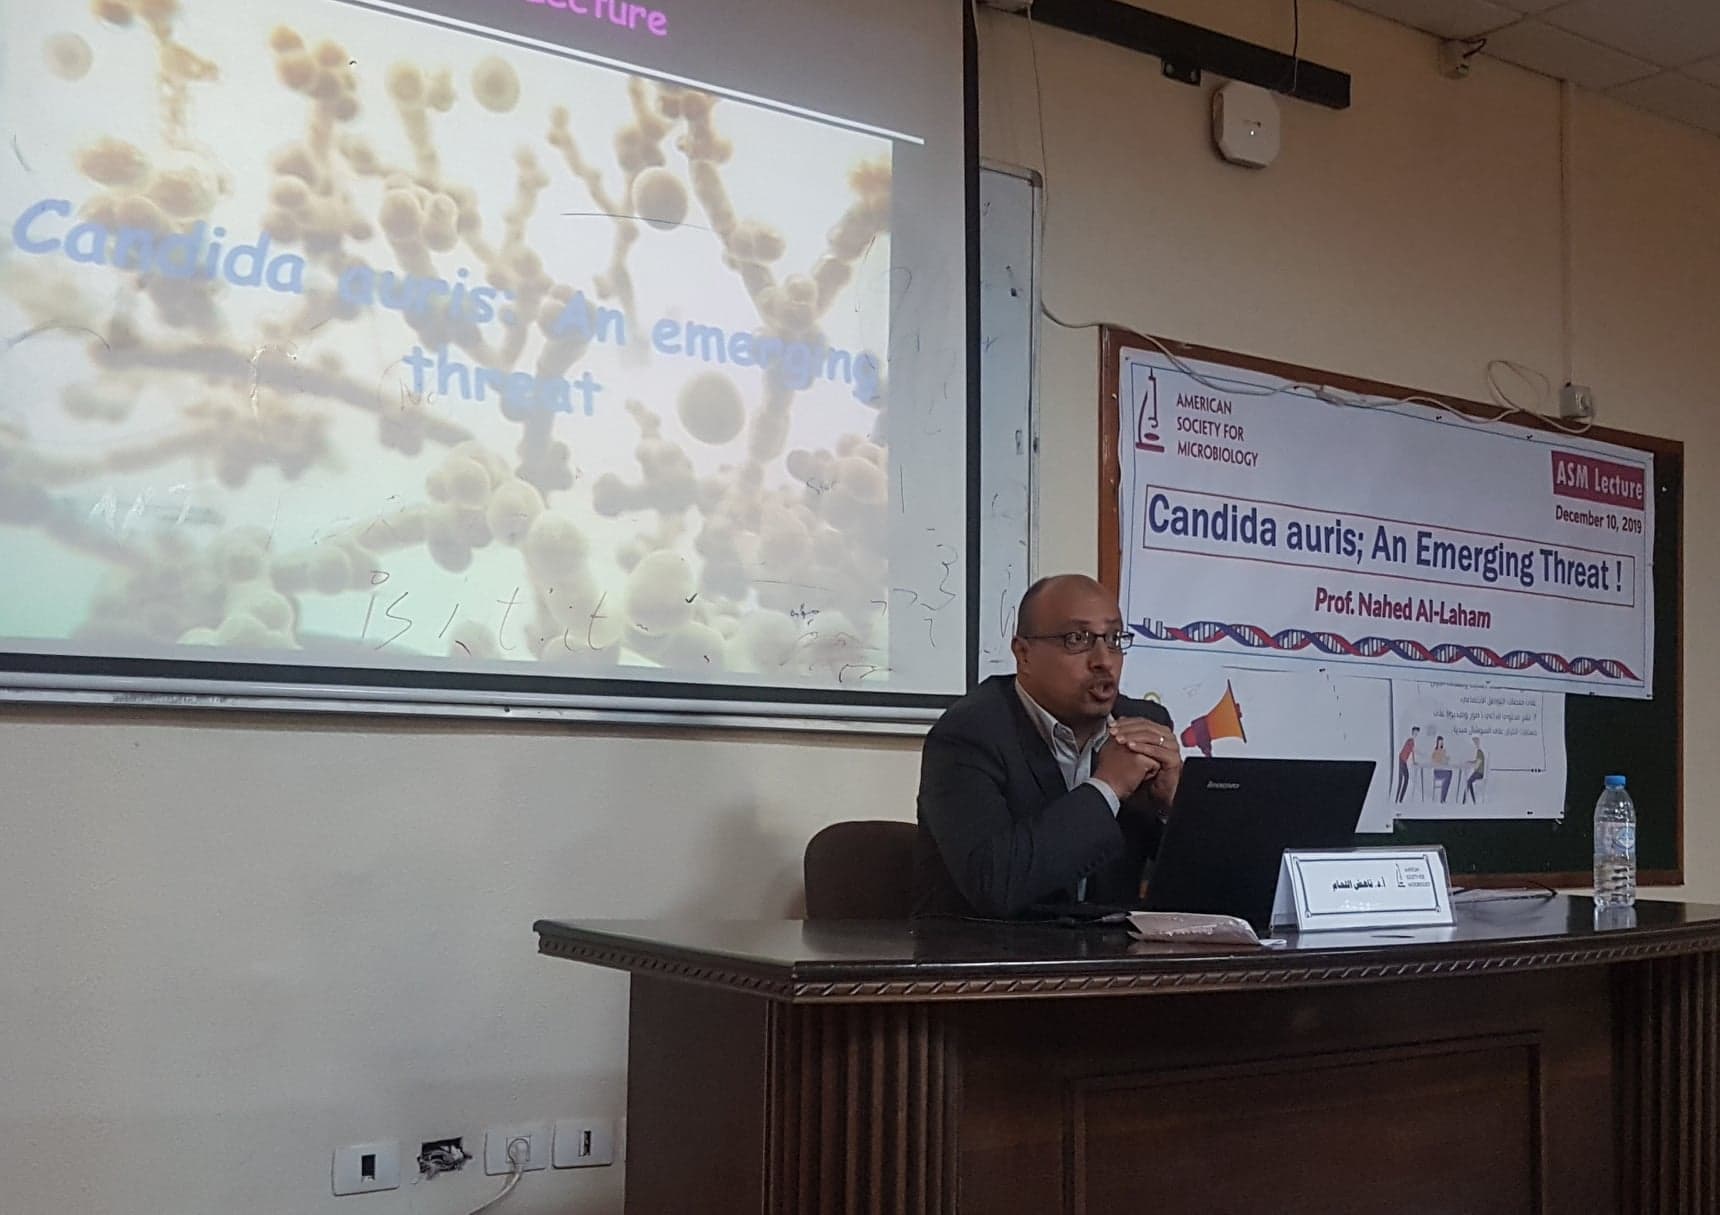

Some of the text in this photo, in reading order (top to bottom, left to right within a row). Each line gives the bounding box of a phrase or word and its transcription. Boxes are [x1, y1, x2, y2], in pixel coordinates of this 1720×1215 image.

[525, 0, 668, 36] cture
[12, 199, 881, 406] Candida auris: An emerging
[403, 346, 602, 416] threat
[1176, 393, 1232, 415] AMERICAN
[1177, 416, 1244, 441] SOCIETY FOR
[1177, 441, 1258, 467] MICROBIOLOGY
[1556, 460, 1643, 500] ASM Lecture
[1555, 505, 1642, 534] December 10, 2019
[1149, 494, 1277, 547] Candida
[1286, 519, 1364, 565] auris;
[1371, 525, 1407, 564] An
[1416, 531, 1535, 588] Emerging
[1540, 549, 1609, 591] Threat
[1315, 587, 1491, 629] Prof. Nahed Al-Laham
